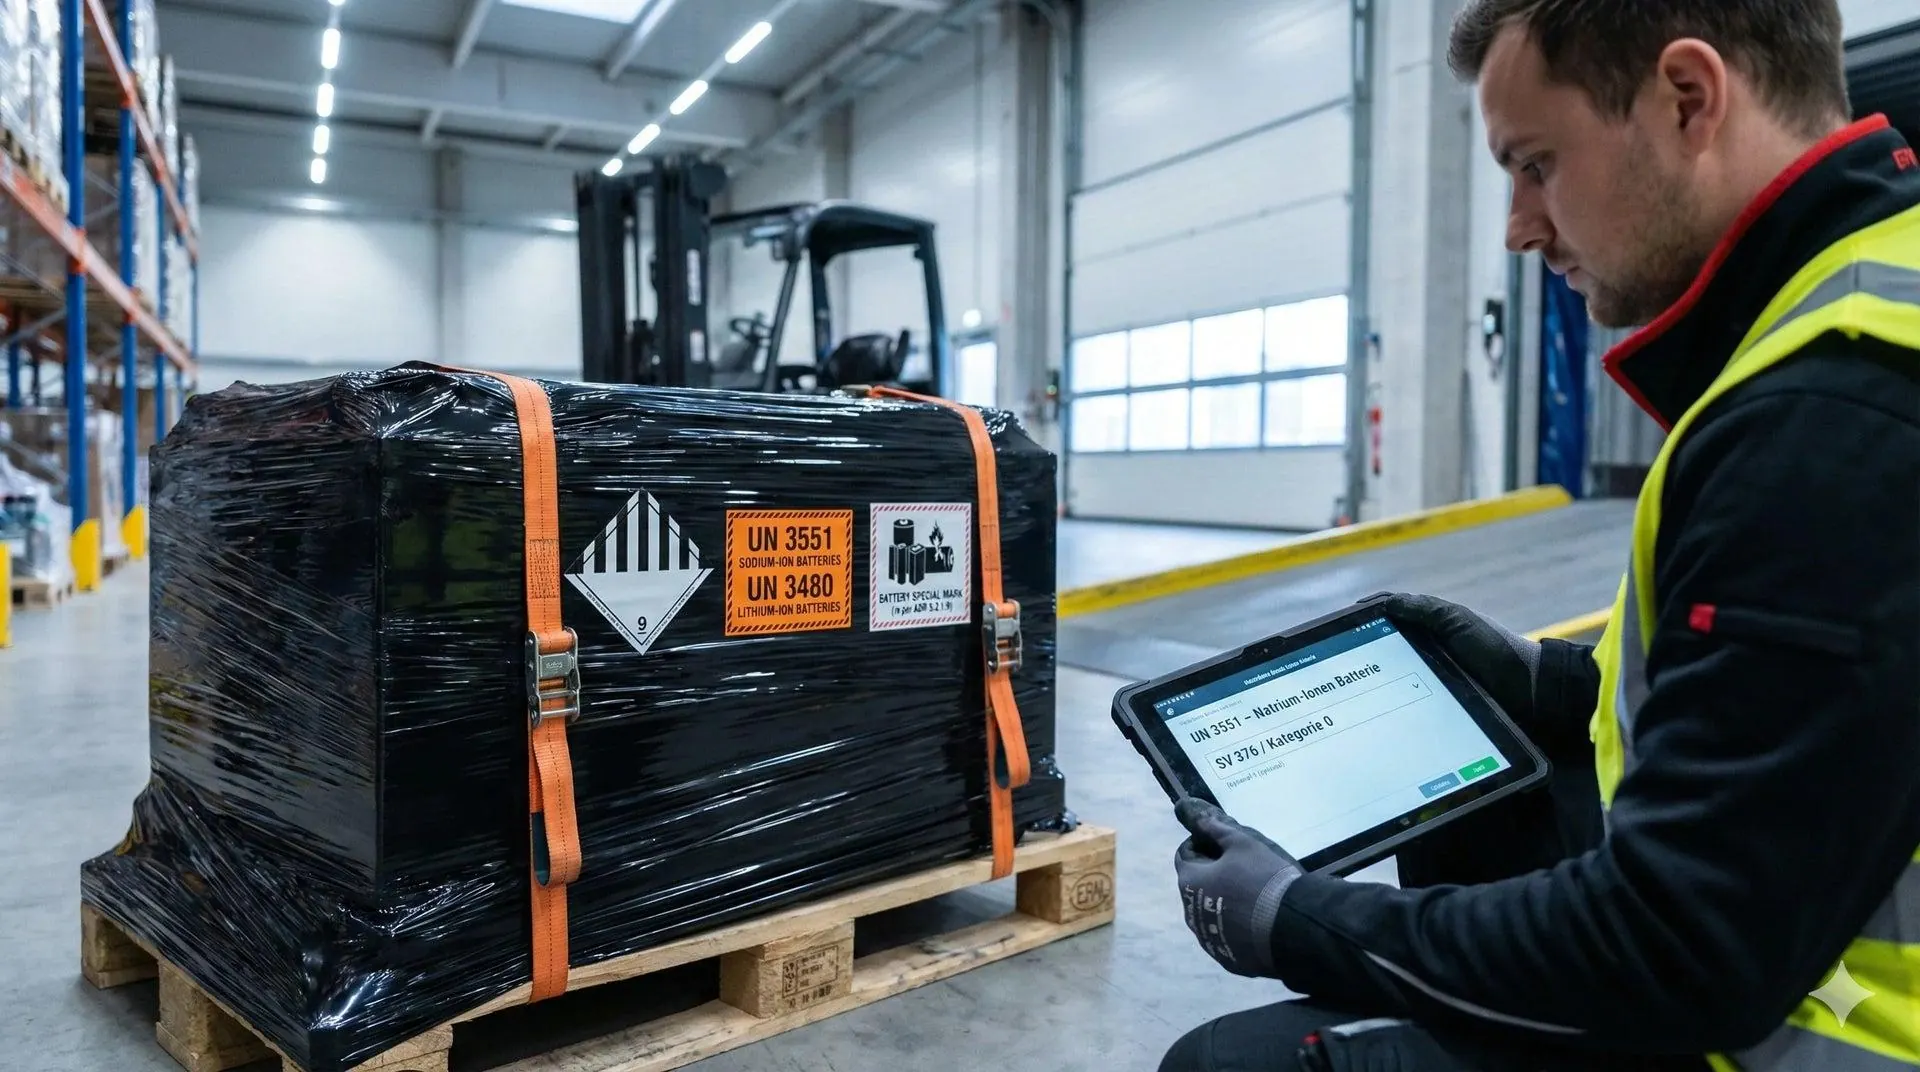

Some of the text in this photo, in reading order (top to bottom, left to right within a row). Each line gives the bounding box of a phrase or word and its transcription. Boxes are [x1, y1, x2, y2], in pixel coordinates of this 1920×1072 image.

[748, 525, 831, 552] UN 3551
[739, 554, 842, 568] SODIUM-ION BATTERIES
[747, 573, 833, 601] UN 3480
[737, 601, 841, 618] LITHIUM-ION BATTERIES
[637, 616, 647, 631] 9
[1190, 727, 1211, 744] UN
[1210, 716, 1242, 737] 3551
[1252, 680, 1337, 719] Natrium-Ionen
[1335, 661, 1382, 688] Batterie
[1215, 753, 1234, 770] SV
[1233, 743, 1260, 763] 376
[1265, 720, 1325, 752] Kategorie
